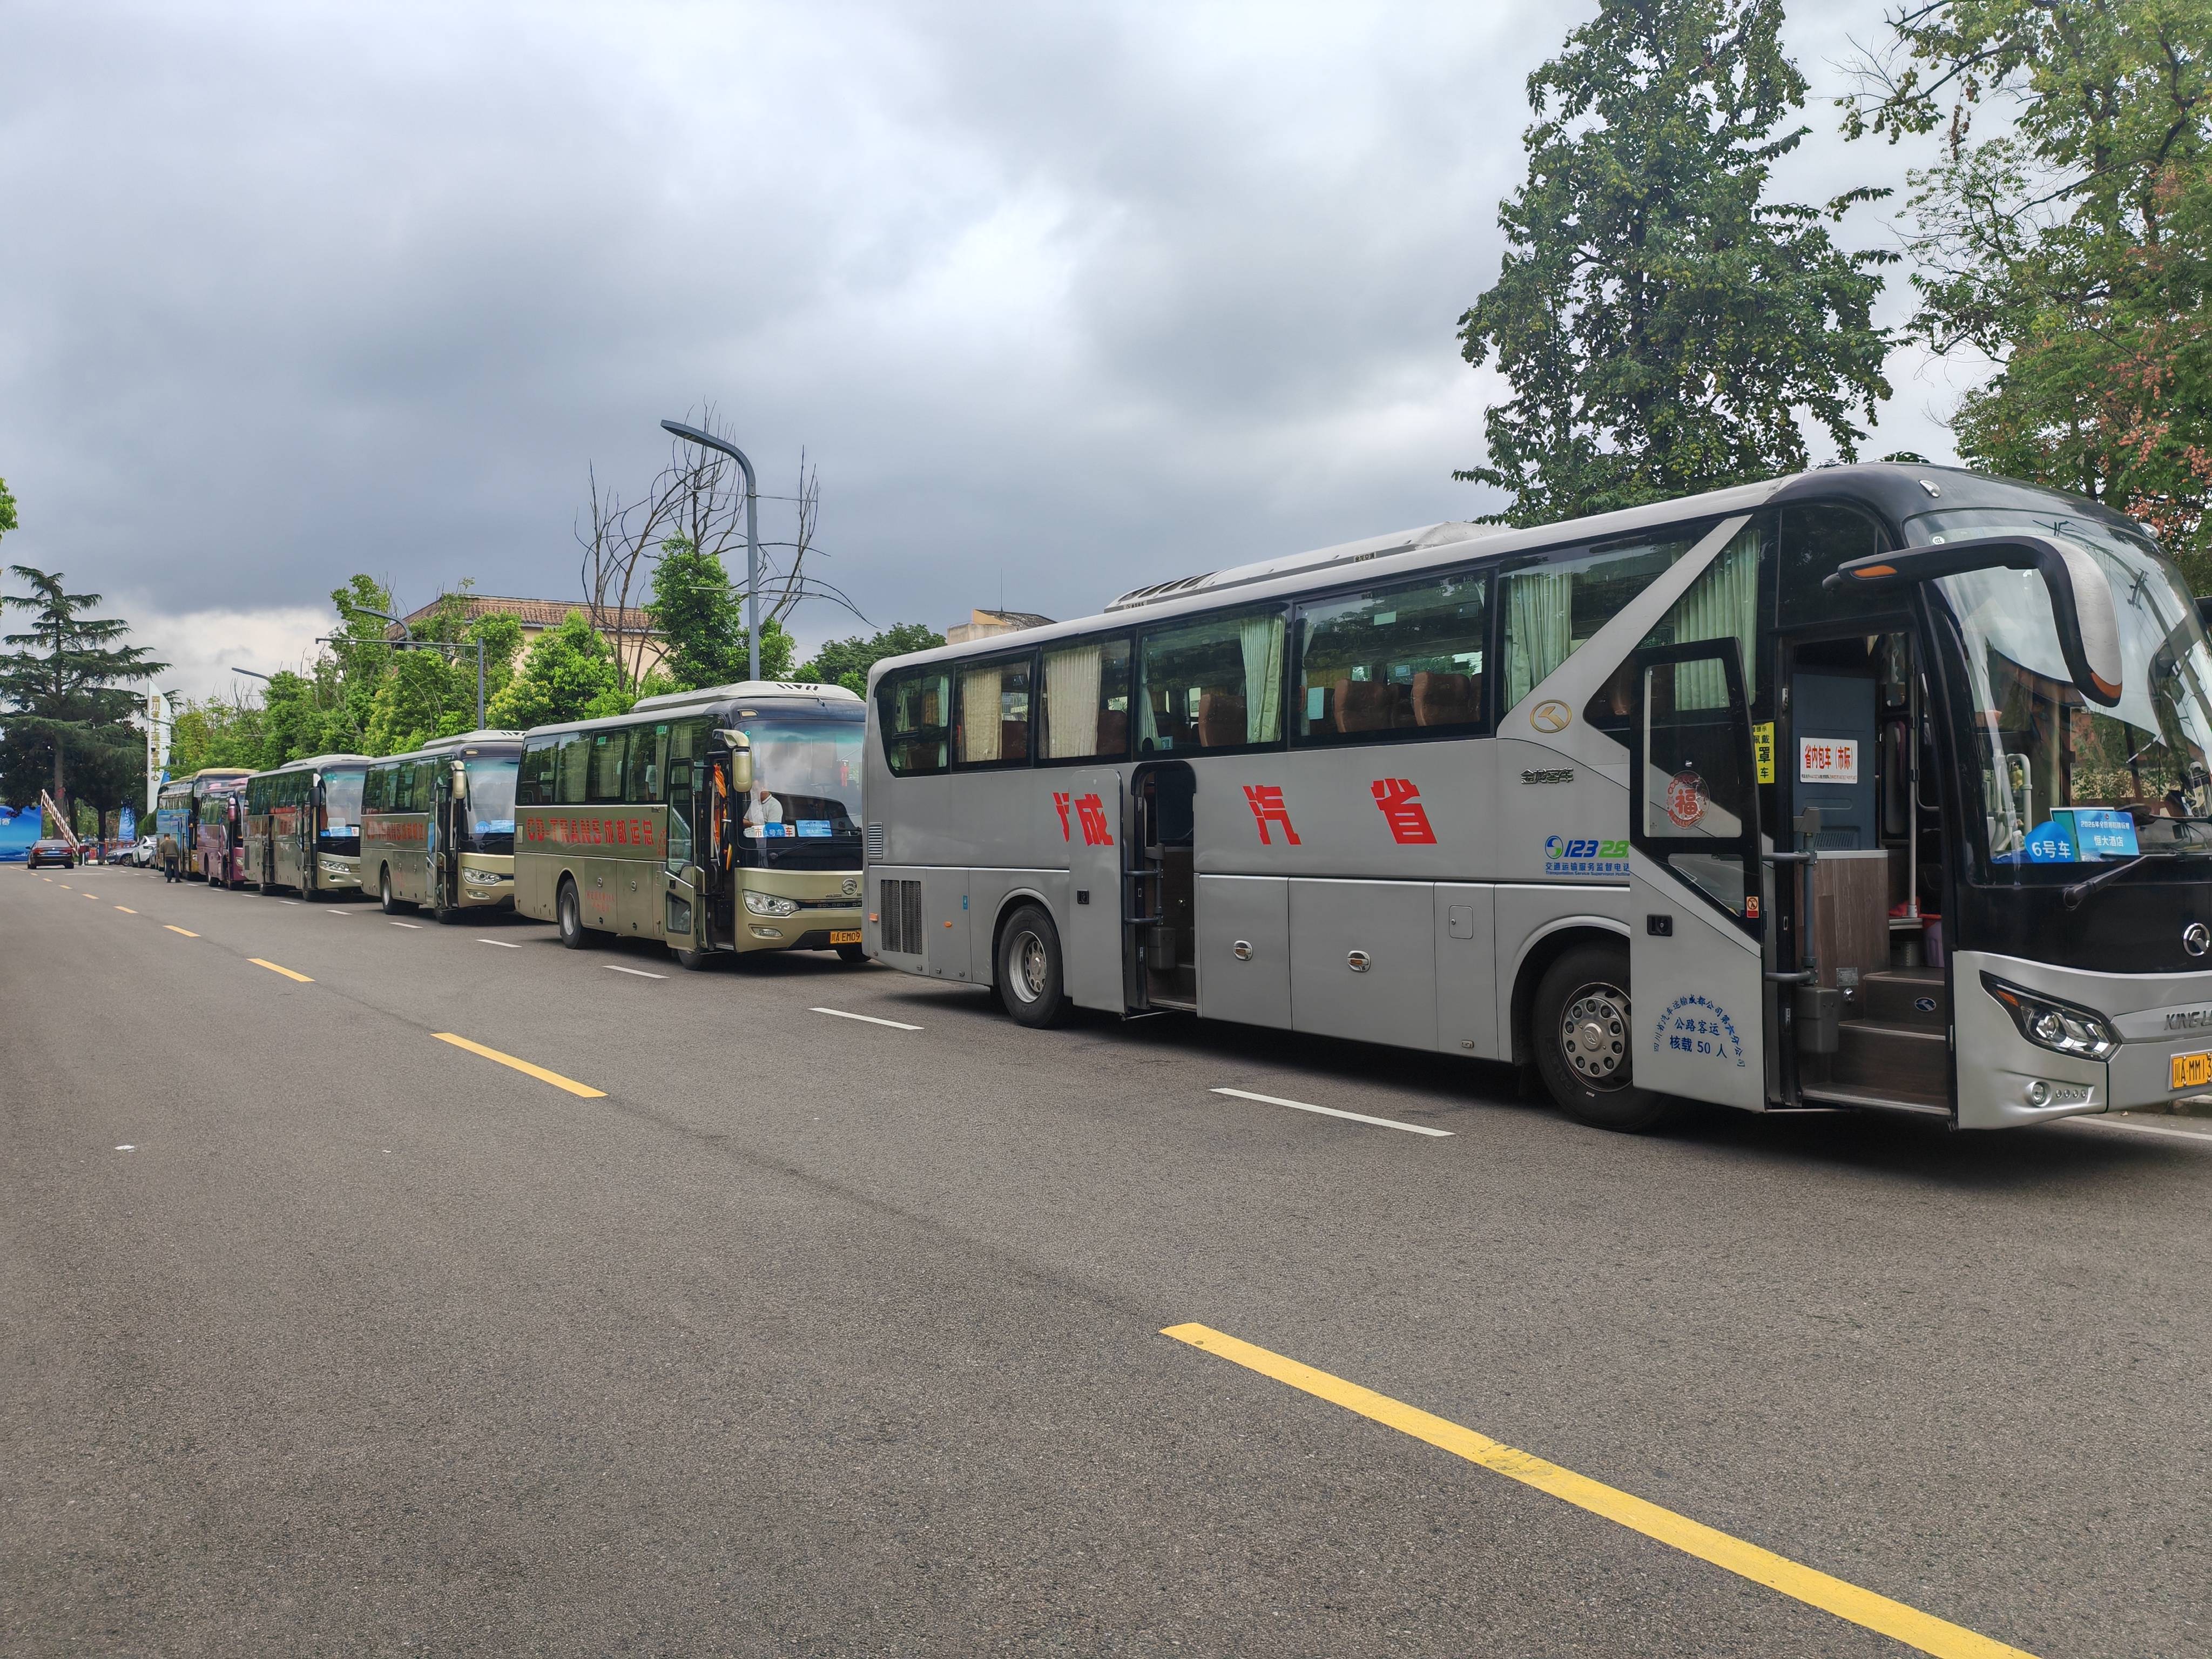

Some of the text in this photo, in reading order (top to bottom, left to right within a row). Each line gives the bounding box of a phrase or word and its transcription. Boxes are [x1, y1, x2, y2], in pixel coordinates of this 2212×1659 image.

[1520, 767, 1574, 784] 金龙客车
[1675, 788, 1698, 815] 福
[2031, 840, 2071, 859] 6号车
[2094, 834, 2124, 847] 恒大酒店
[1674, 1016, 1720, 1036] 公路客运
